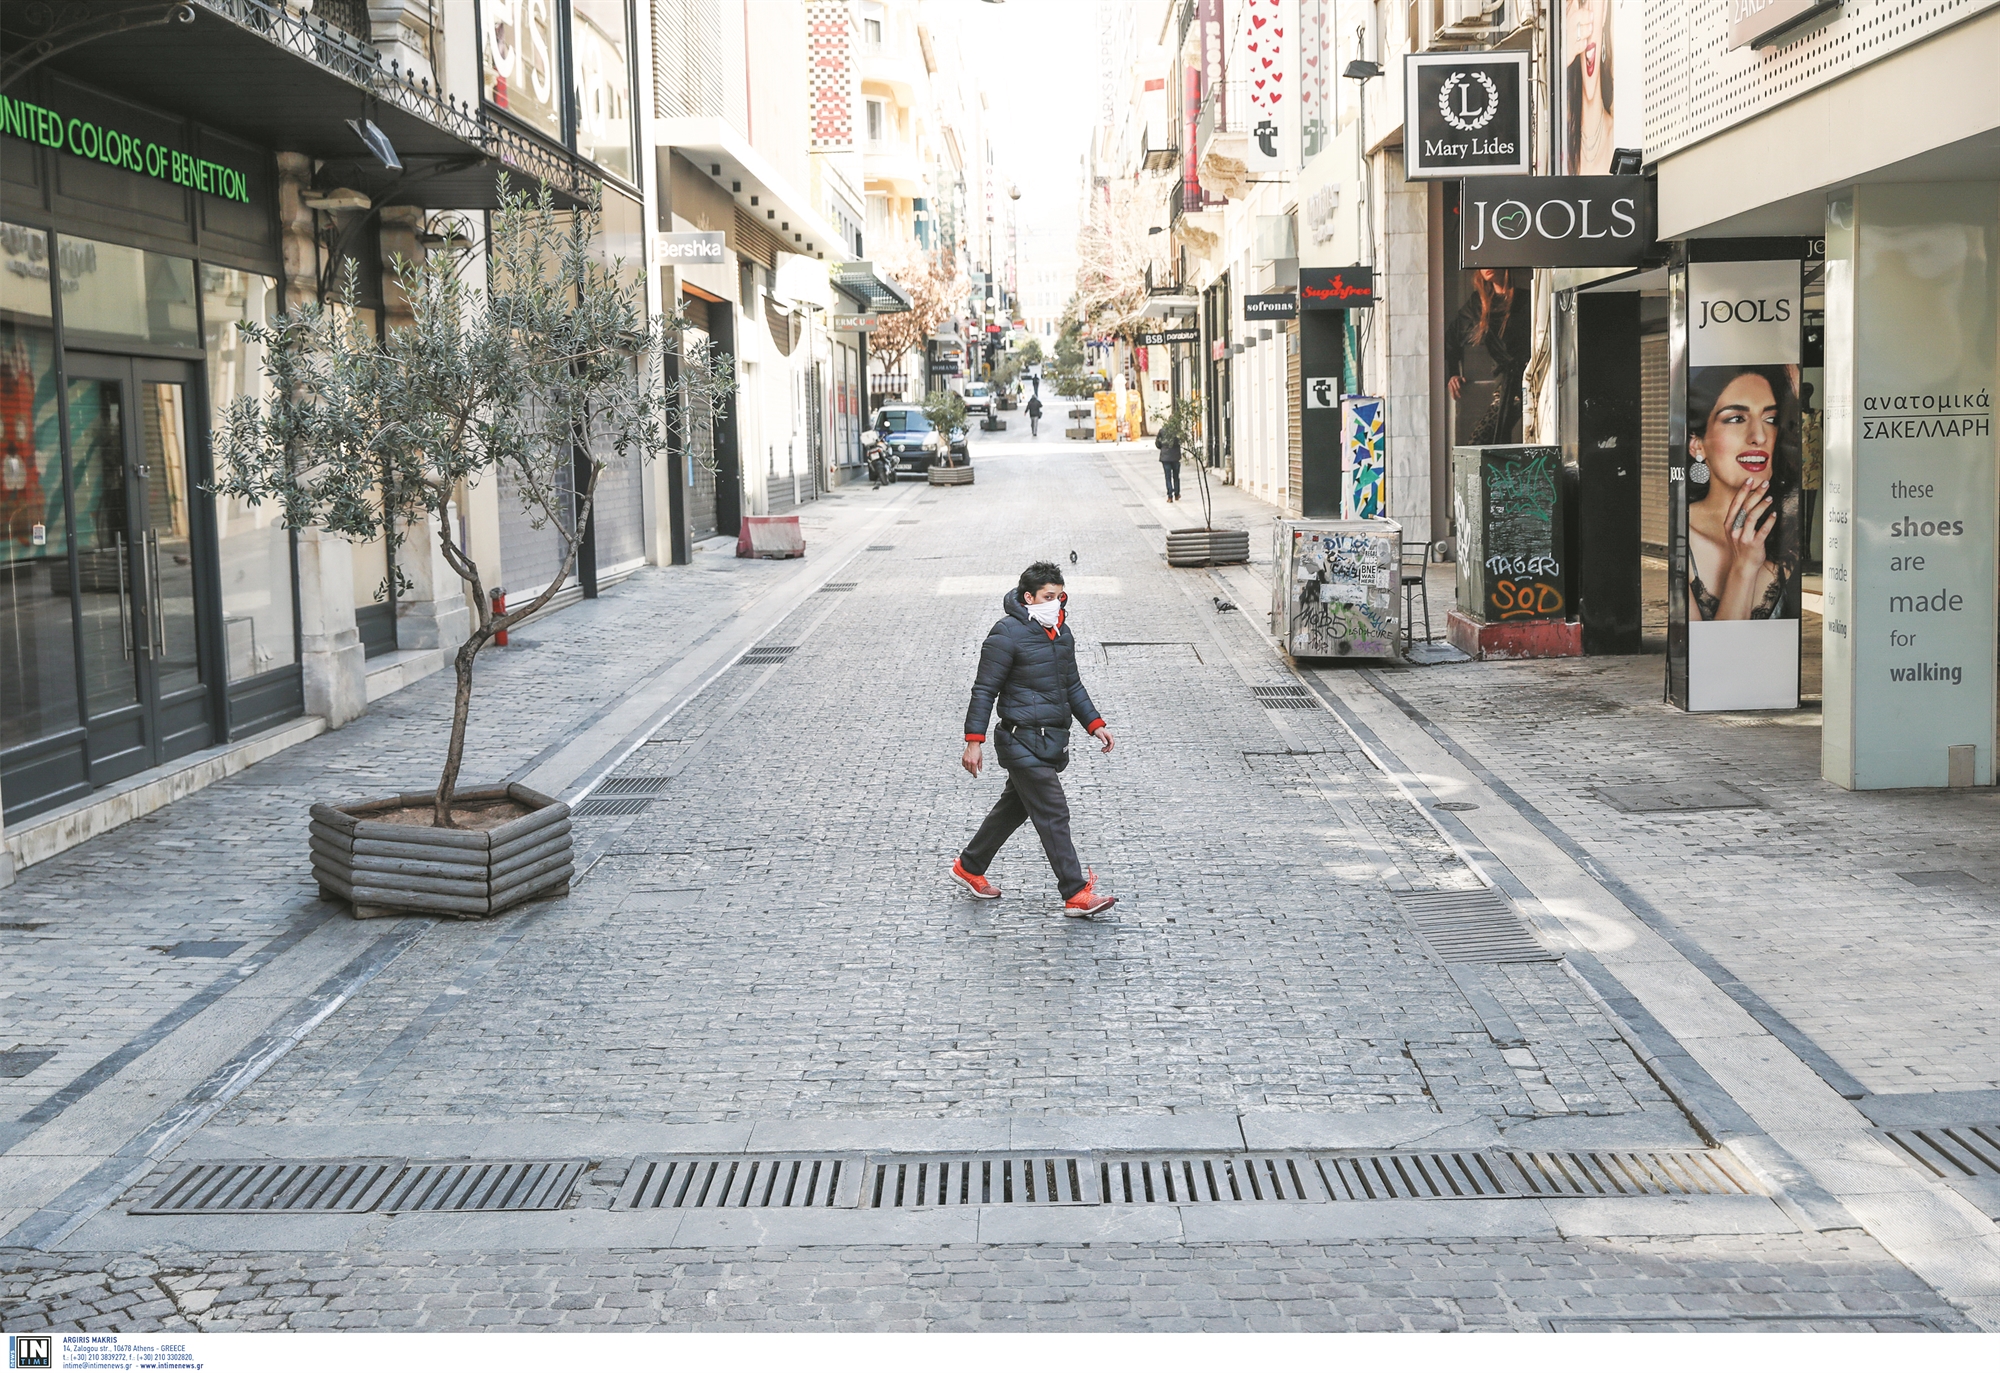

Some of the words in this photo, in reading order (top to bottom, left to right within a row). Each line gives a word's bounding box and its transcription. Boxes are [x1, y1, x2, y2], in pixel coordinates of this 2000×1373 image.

[1458, 83, 1483, 117] L
[67, 118, 143, 173] COLORS
[146, 143, 168, 179] OF
[1424, 139, 1468, 159] Mary
[1472, 137, 1515, 155] Lides
[1470, 198, 1636, 251] JOOLS
[658, 239, 721, 257] Bershka
[1301, 284, 1371, 300] Sugarfree
[1247, 301, 1293, 312] sofronas
[1699, 299, 1790, 329] JOOLS
[1145, 334, 1163, 344] BSB
[1864, 388, 1990, 413] ανατομικά
[1863, 418, 1989, 439] ΣΑΚΕΛΛΑΡΗ
[1891, 480, 1934, 499] these
[1828, 507, 1848, 524] shoes
[1890, 516, 1964, 537] shoes
[1361, 565, 1376, 574] BNE
[1828, 563, 1848, 582] made
[1890, 555, 1925, 571] are
[1889, 588, 1963, 613] made
[1828, 619, 1847, 639] walking
[1890, 629, 1917, 647] for
[1890, 662, 1963, 685] walking
